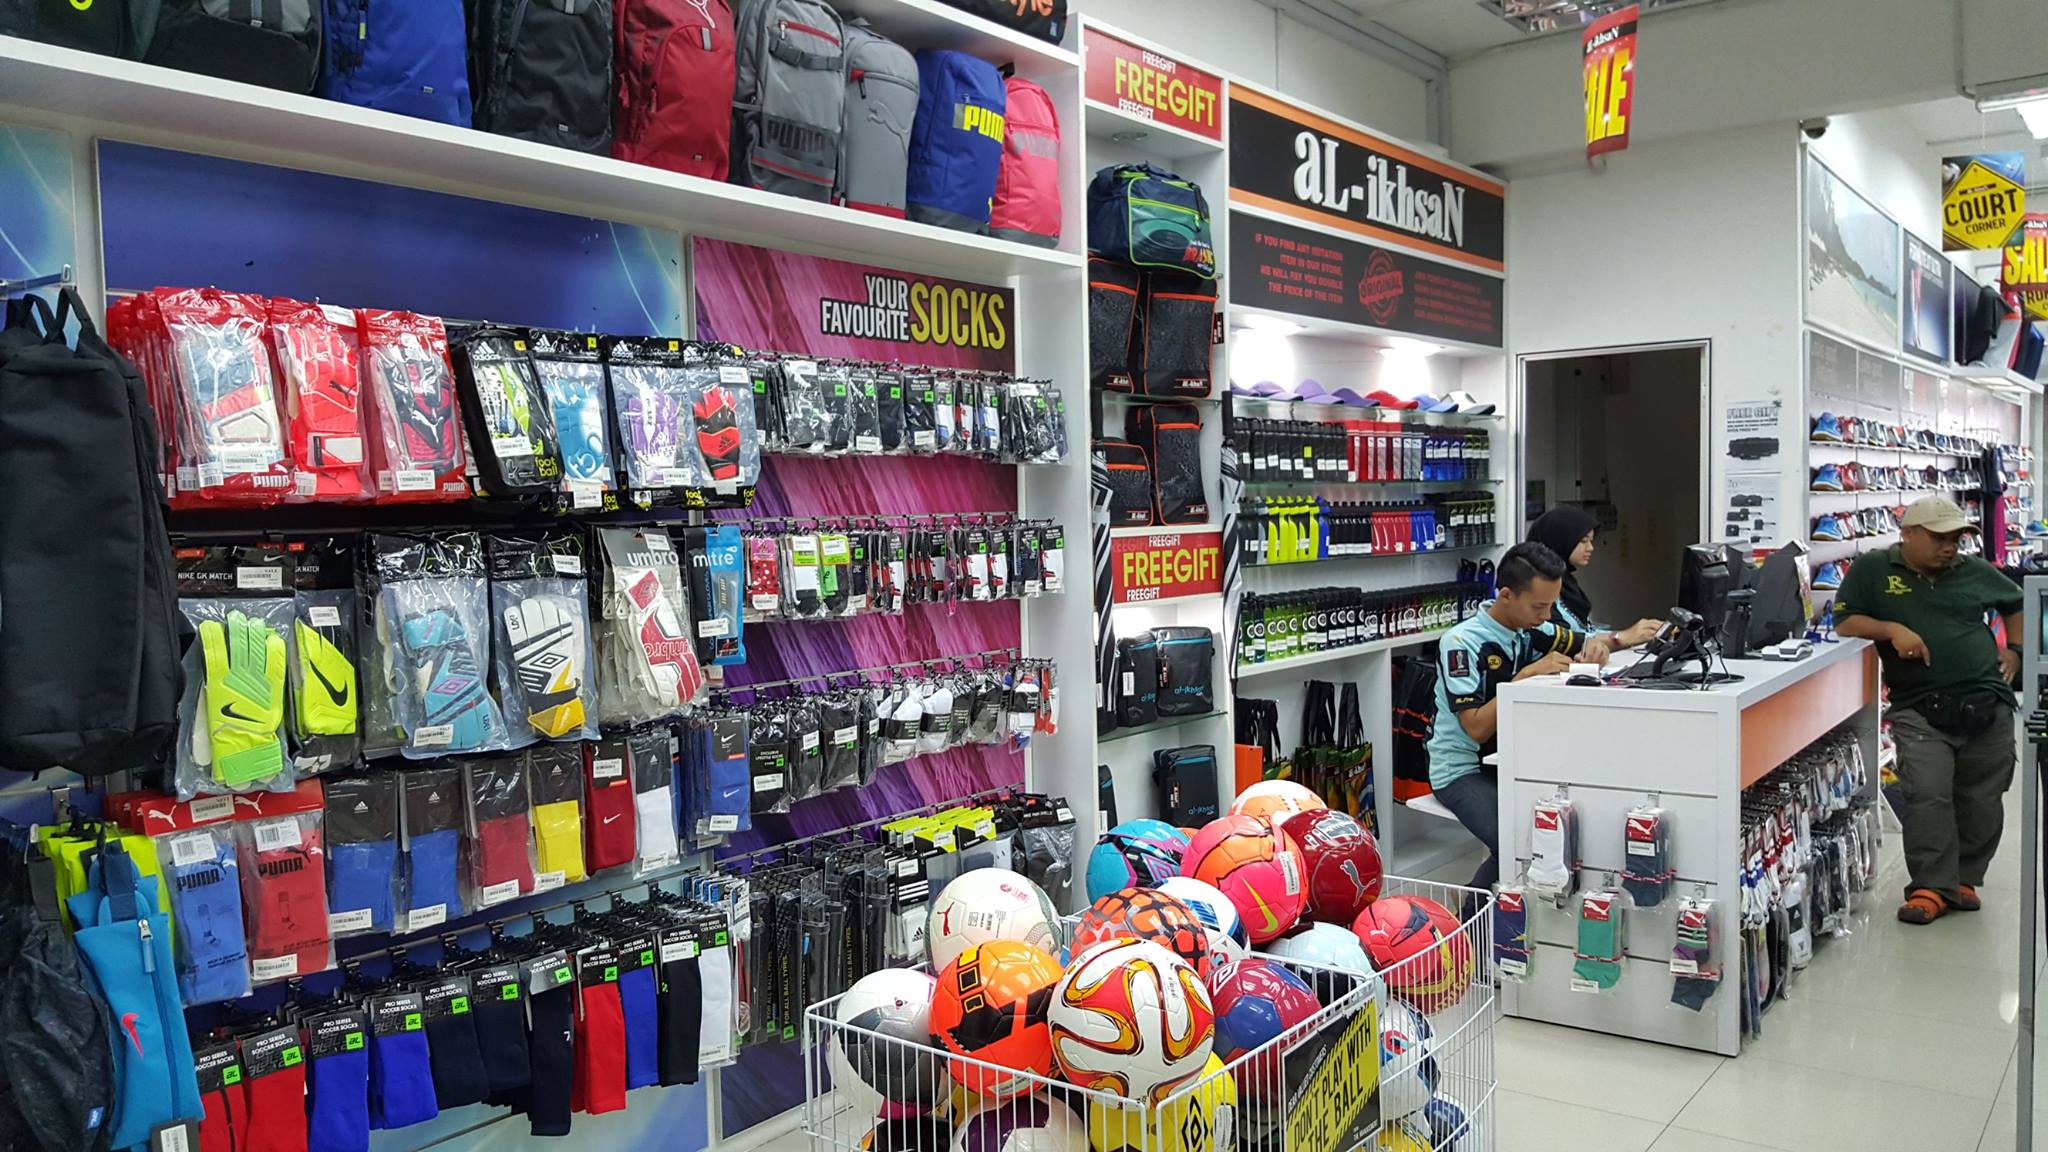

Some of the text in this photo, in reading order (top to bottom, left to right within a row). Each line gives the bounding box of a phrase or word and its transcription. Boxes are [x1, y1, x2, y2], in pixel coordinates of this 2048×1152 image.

[1115, 56, 1216, 127] FREEGIFT
[1584, 48, 1630, 144] ALE
[963, 104, 1004, 144] PUM
[766, 119, 825, 151] PUMA
[1294, 131, 1465, 247] aL-ikhsaN
[1944, 189, 2017, 227] COURT
[1965, 218, 2006, 235] CORNER
[1263, 234, 1278, 248] YOU
[1279, 239, 1296, 251] FIND
[1280, 254, 1297, 266] ITEM
[1306, 259, 1320, 271] OUR
[2004, 235, 2048, 285] SAL
[1260, 265, 1271, 276] WE
[1271, 267, 1289, 279] WILL
[1290, 271, 1303, 281] PAY
[1303, 274, 1317, 285] YOU
[865, 275, 908, 311] YOUR
[1268, 281, 1343, 304] THE PRICE OF THE ITEM
[1360, 275, 1402, 300] ORIGINAL
[821, 300, 910, 341] FAVOURITE
[910, 282, 1006, 350] SOCKS
[535, 456, 556, 466] foot
[539, 466, 557, 477] ball
[443, 482, 465, 491] PUMA
[1149, 535, 1180, 547] FREEGIFT
[627, 551, 679, 567] umbro
[693, 552, 734, 567] mitre
[1123, 547, 1218, 587] FREEGIFT
[1127, 587, 1160, 601] FREEGIFT
[259, 857, 303, 877] PUMA
[177, 868, 220, 891] PUMA
[498, 975, 514, 983] SOCKS
[446, 988, 462, 997] SOCKS
[341, 1022, 358, 1030] SOCKS
[269, 1034, 285, 1042] SERIES
[275, 1037, 293, 1047] SOCKS
[200, 1051, 227, 1063] PRO SERIES
[217, 1055, 234, 1064] SOCKS
[1322, 1051, 1343, 1110] PLAY
[1347, 1015, 1371, 1068] WITH
[1309, 1064, 1363, 1152] THE BALL
